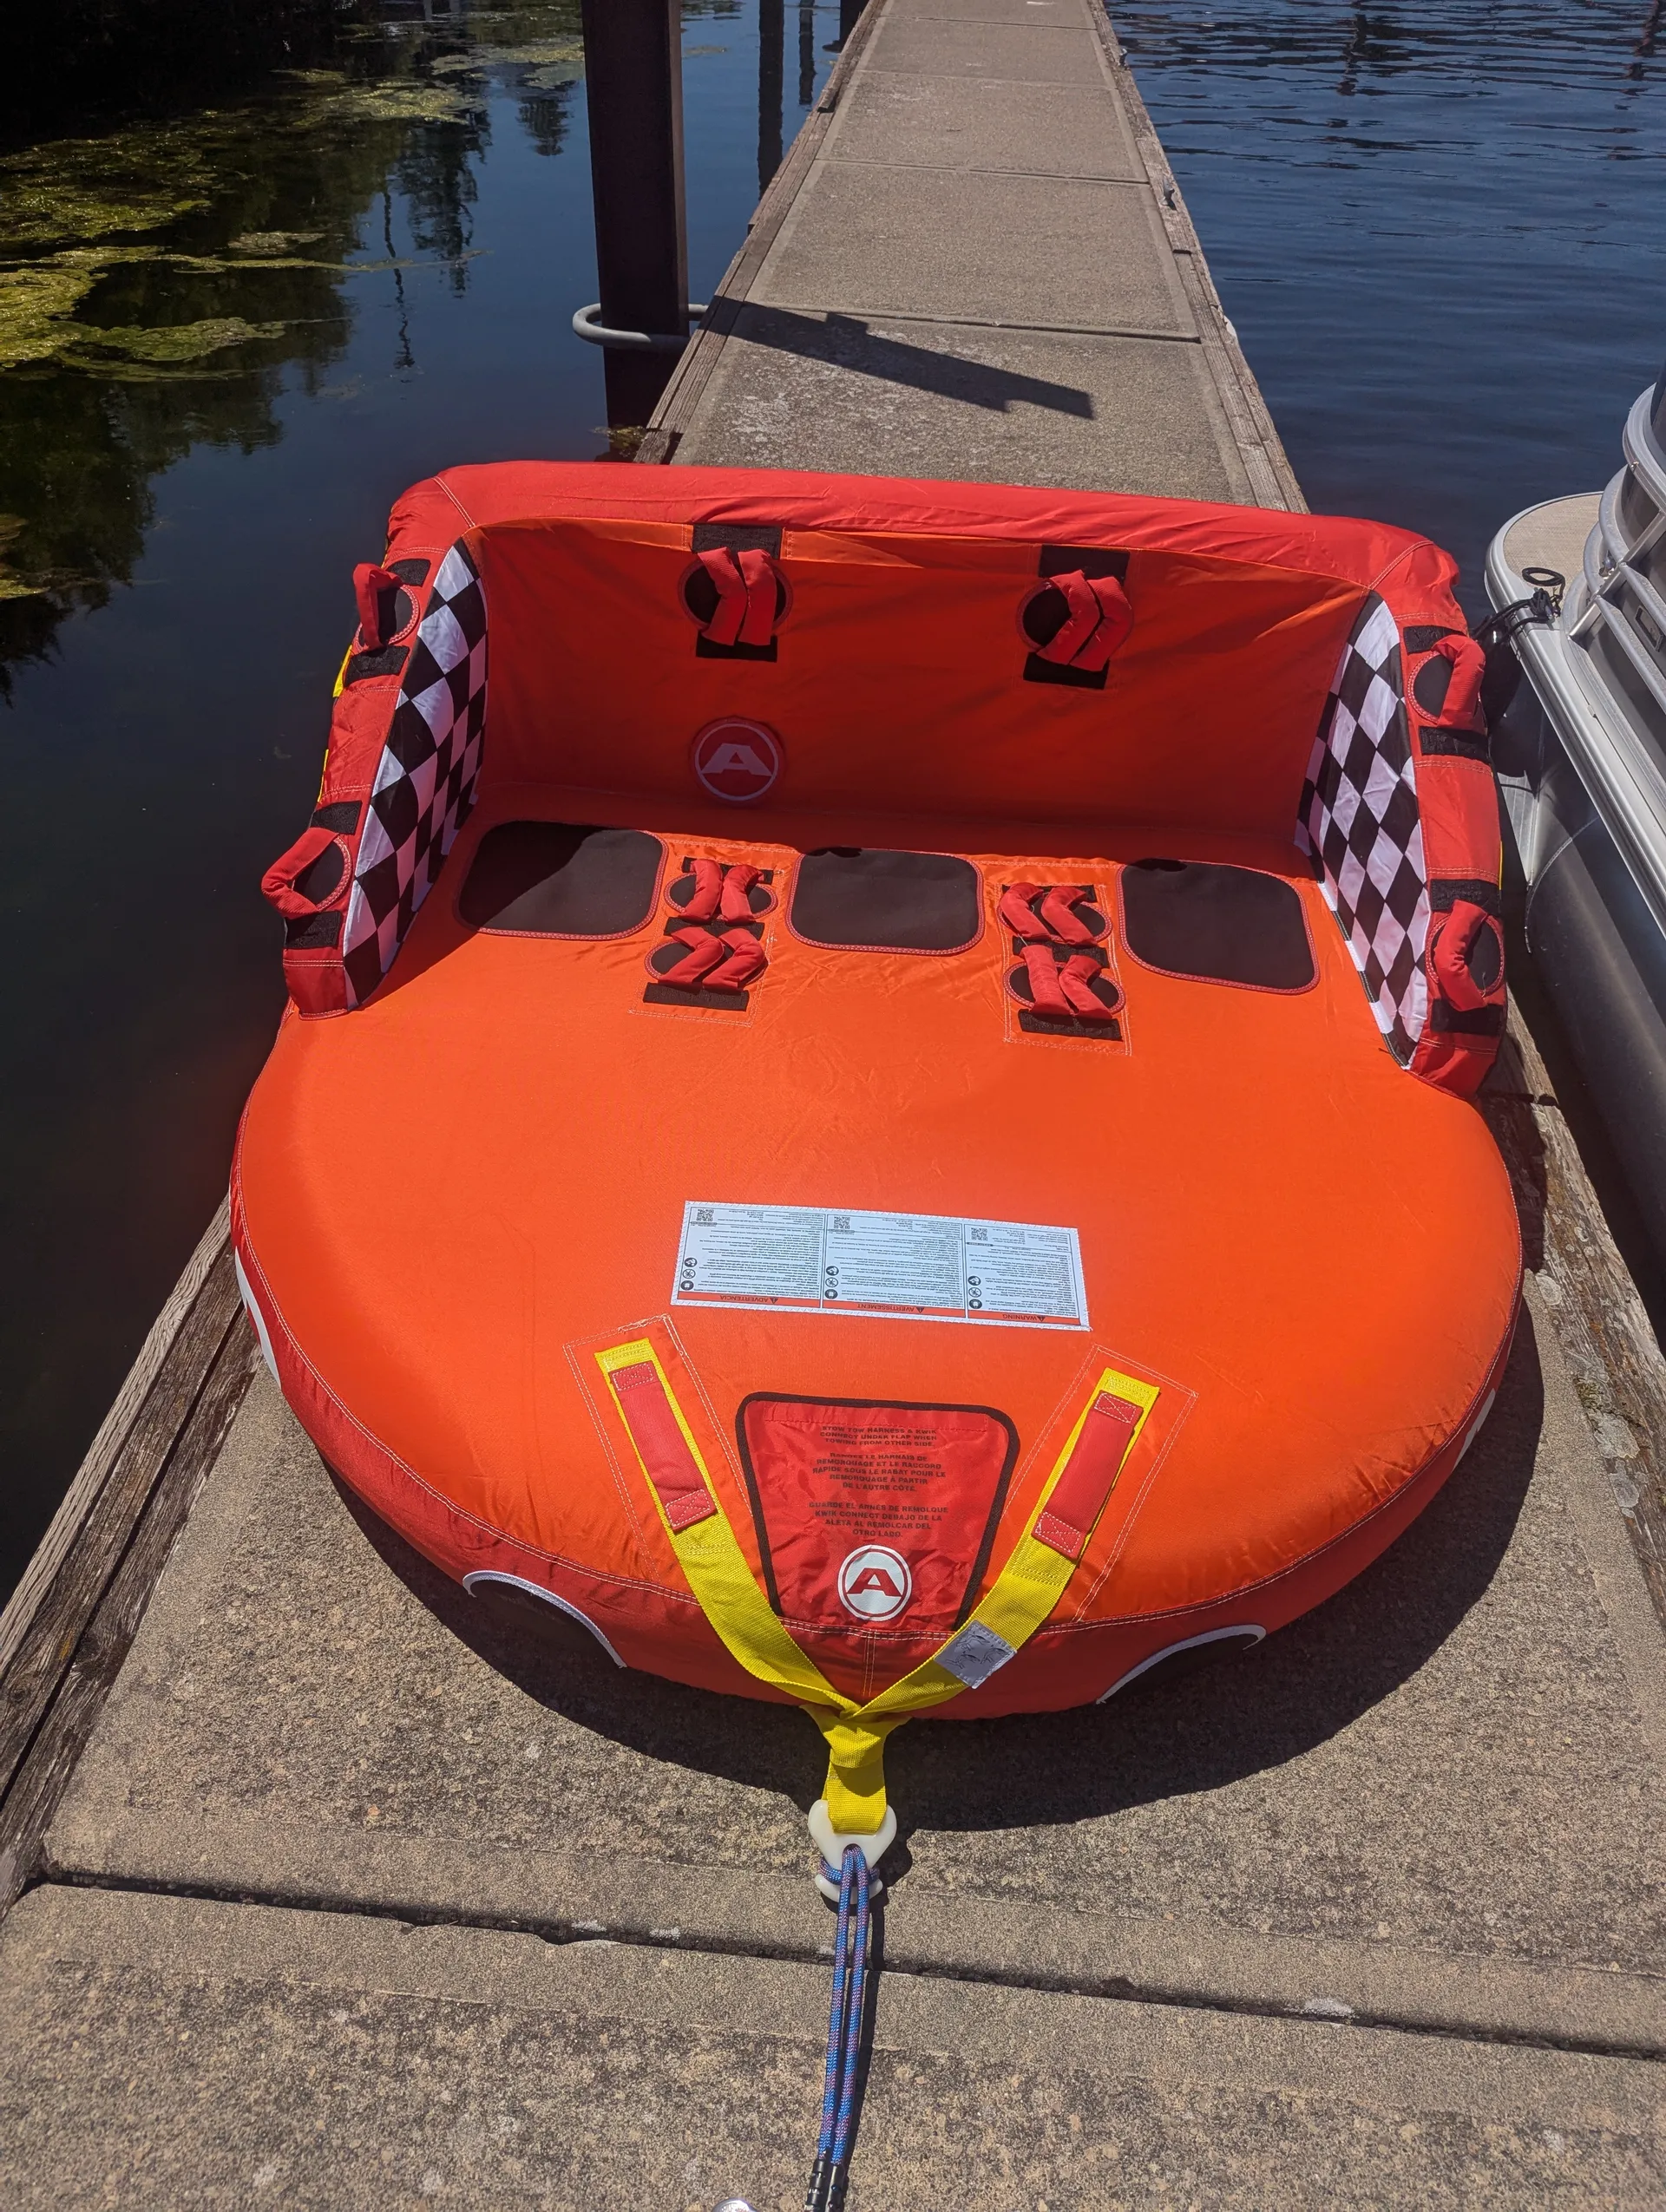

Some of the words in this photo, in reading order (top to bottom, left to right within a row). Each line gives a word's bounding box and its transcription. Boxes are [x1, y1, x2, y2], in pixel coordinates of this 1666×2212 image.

[857, 1303, 915, 1312] AVERTISSEMENT
[820, 1431, 858, 1440] CONNECT
[817, 1458, 875, 1467] REMORQUAGE
[830, 1474, 889, 1482] REMORQUAGE
[839, 1510, 880, 1519] CONNECT
[867, 1521, 913, 1529] REMOLCAR
[852, 1528, 876, 1536] OTRO
